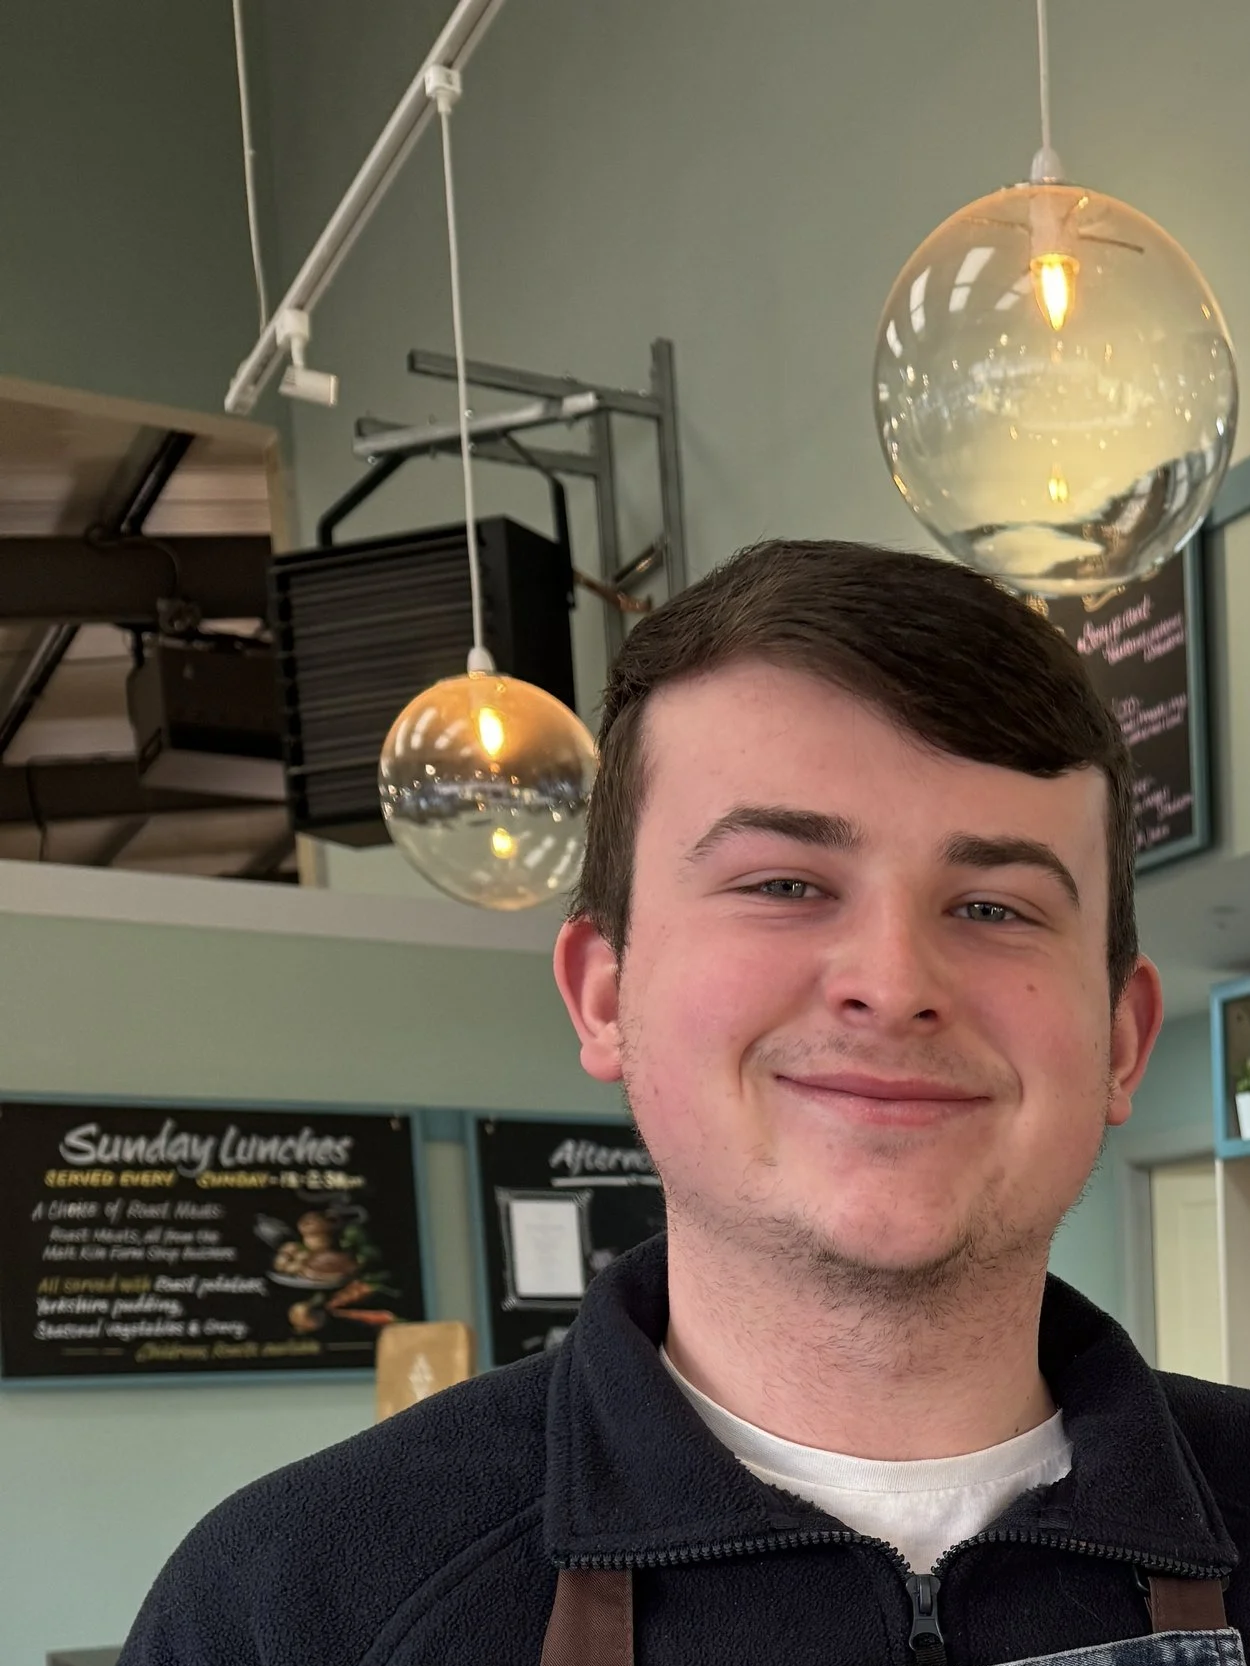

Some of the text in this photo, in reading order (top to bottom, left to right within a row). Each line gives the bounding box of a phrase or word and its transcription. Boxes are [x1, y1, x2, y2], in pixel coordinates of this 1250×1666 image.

[59, 1117, 354, 1178] Sunday Lunches
[44, 1169, 115, 1188] SERVED
[119, 1169, 176, 1188] EVERY
[31, 1200, 43, 1222] A
[47, 1198, 100, 1221] Choice
[36, 1294, 110, 1316] Yorkshire
[34, 1317, 104, 1341] Seasonal
[103, 1316, 186, 1342] vegetables
